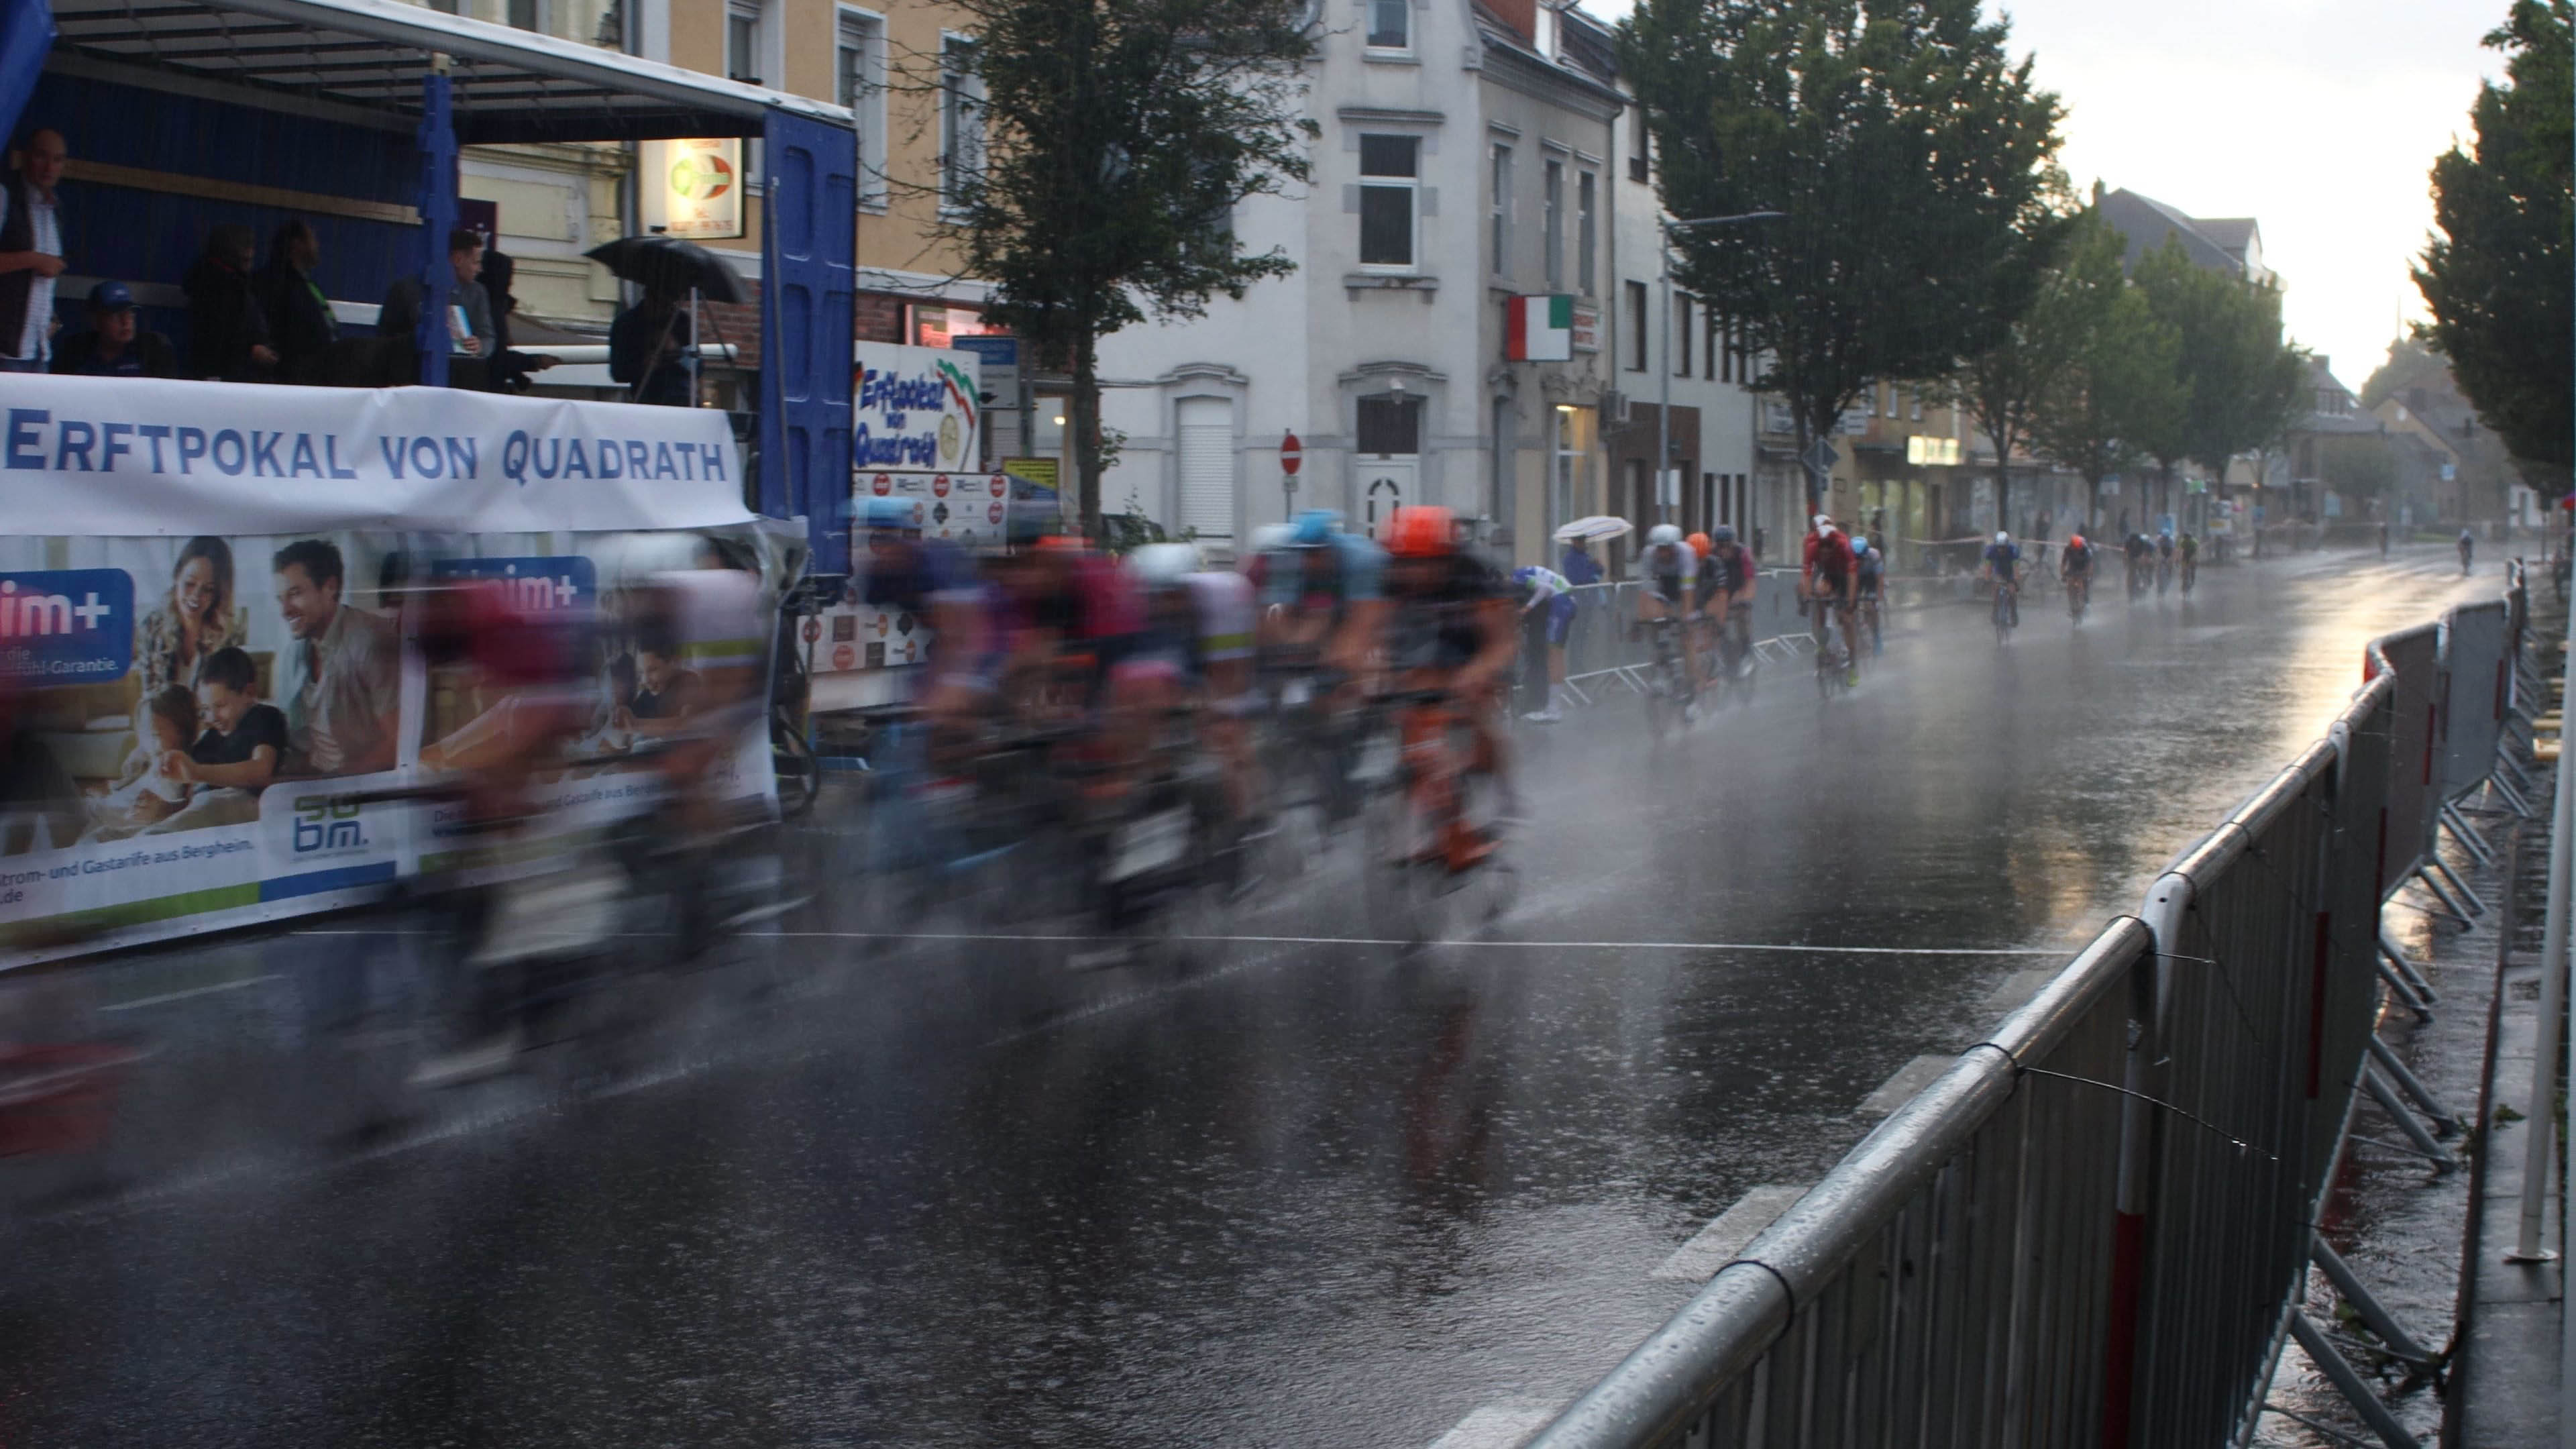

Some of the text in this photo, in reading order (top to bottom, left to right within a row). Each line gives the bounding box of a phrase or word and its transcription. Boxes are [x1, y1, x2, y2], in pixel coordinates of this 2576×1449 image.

[380, 435, 478, 480] VON
[502, 429, 728, 486] QUADRATH
[50, 861, 78, 879] und
[82, 851, 150, 874] Gastarife
[154, 850, 179, 864] aus
